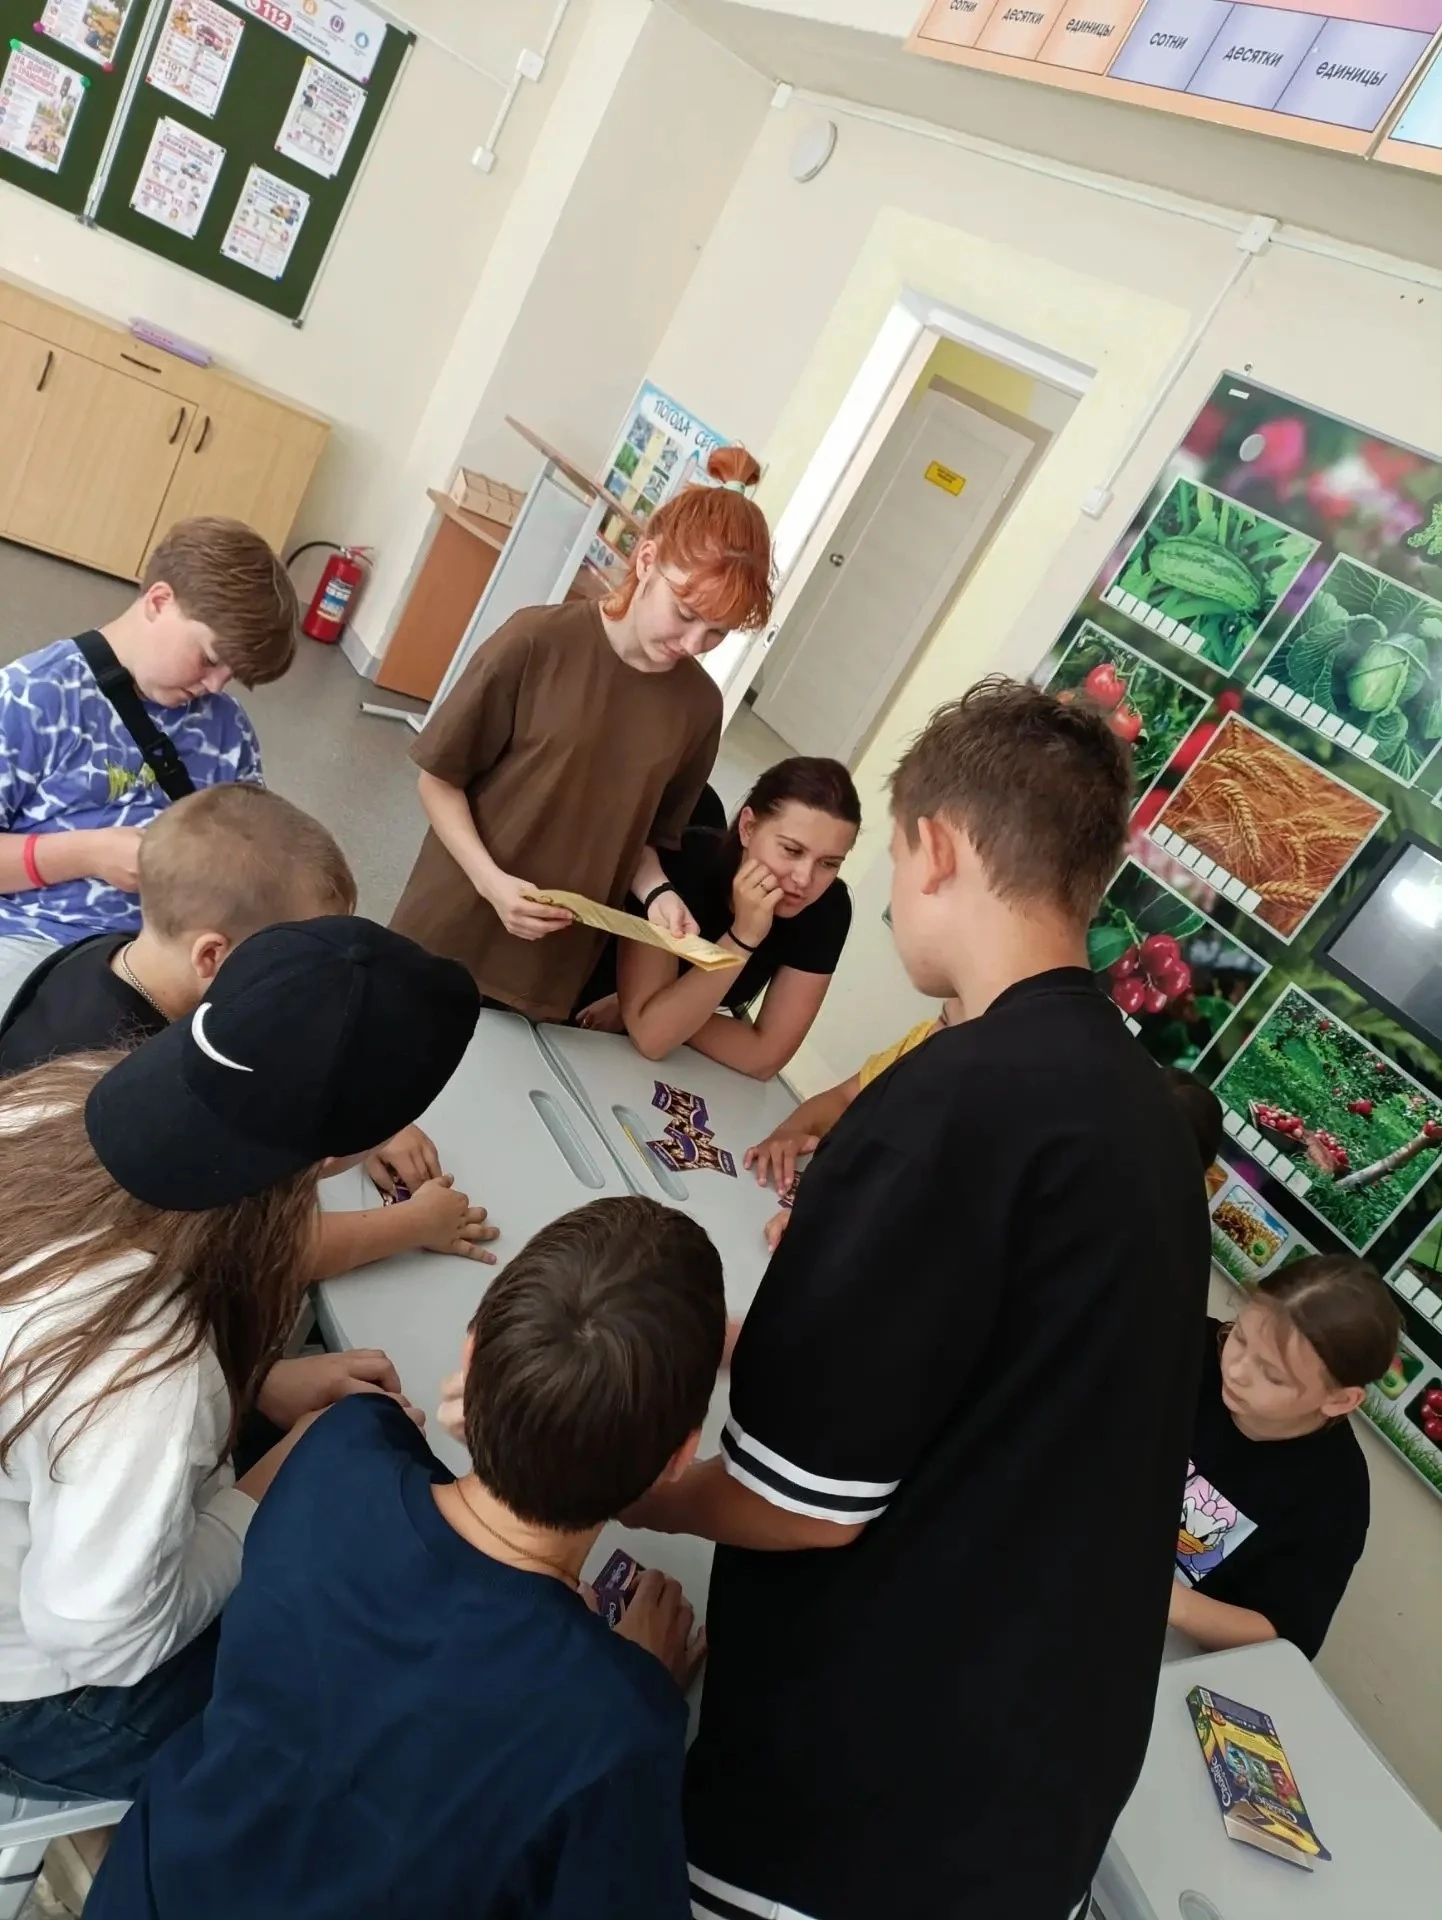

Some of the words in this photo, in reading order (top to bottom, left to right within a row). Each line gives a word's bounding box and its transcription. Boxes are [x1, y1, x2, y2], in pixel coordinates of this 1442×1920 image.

[262, 3, 288, 28] 112
[950, 0, 977, 12] сотни
[1002, 8, 1045, 25] десятки
[1065, 19, 1116, 38] единицы
[1150, 32, 1188, 50] сотни
[1223, 45, 1283, 67] десятки
[1316, 61, 1388, 87] единицы
[654, 401, 691, 436] ПОГОДА
